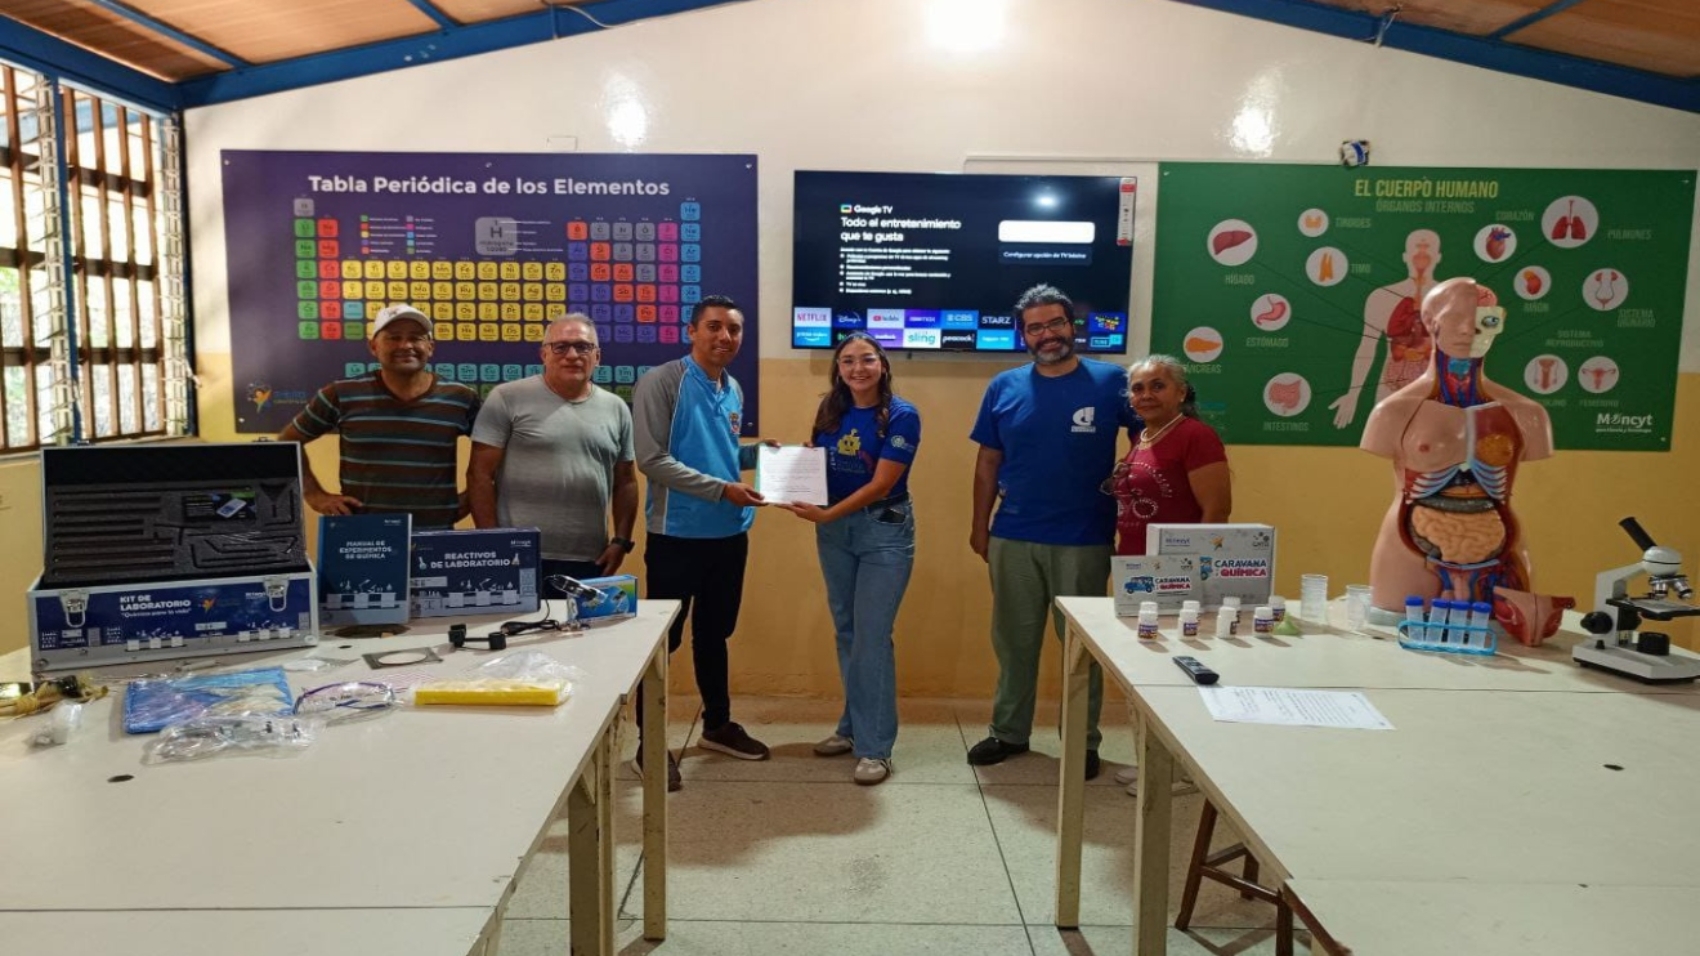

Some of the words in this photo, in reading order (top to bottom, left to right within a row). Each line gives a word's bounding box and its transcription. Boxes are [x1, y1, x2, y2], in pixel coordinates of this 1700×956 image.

[308, 175, 367, 192] Tabla
[374, 175, 477, 193] Periódica
[483, 177, 511, 194] de
[516, 177, 547, 194] los
[554, 178, 670, 195] Elementos
[1355, 179, 1372, 197] EL
[1435, 180, 1499, 199] HUMANO
[854, 205, 882, 215] Google
[883, 206, 894, 214] TV
[1376, 198, 1423, 212] ÓRGANOS
[1425, 201, 1475, 213] INTERNOS
[841, 217, 868, 227] Todo
[869, 217, 879, 227] el
[881, 218, 962, 229] entretenimiento
[490, 227, 503, 239] H
[841, 231, 860, 242] que
[862, 232, 873, 241] te
[875, 232, 904, 244] gusta
[797, 312, 827, 322] NETFLIX
[981, 316, 1012, 324] STARZ
[908, 331, 936, 345] sling
[1184, 363, 1222, 373] ÁNCREAS
[1263, 421, 1309, 432] INTESTINOS
[444, 551, 497, 560] REACTIVOS
[431, 561, 443, 569] DE
[445, 559, 511, 569] LABORATORIO
[1214, 559, 1267, 568] CARAVANA
[1220, 567, 1267, 577] QUÍMICA
[120, 595, 135, 604] KIT
[138, 594, 151, 602] DE
[120, 599, 191, 611] LABORATORIO
